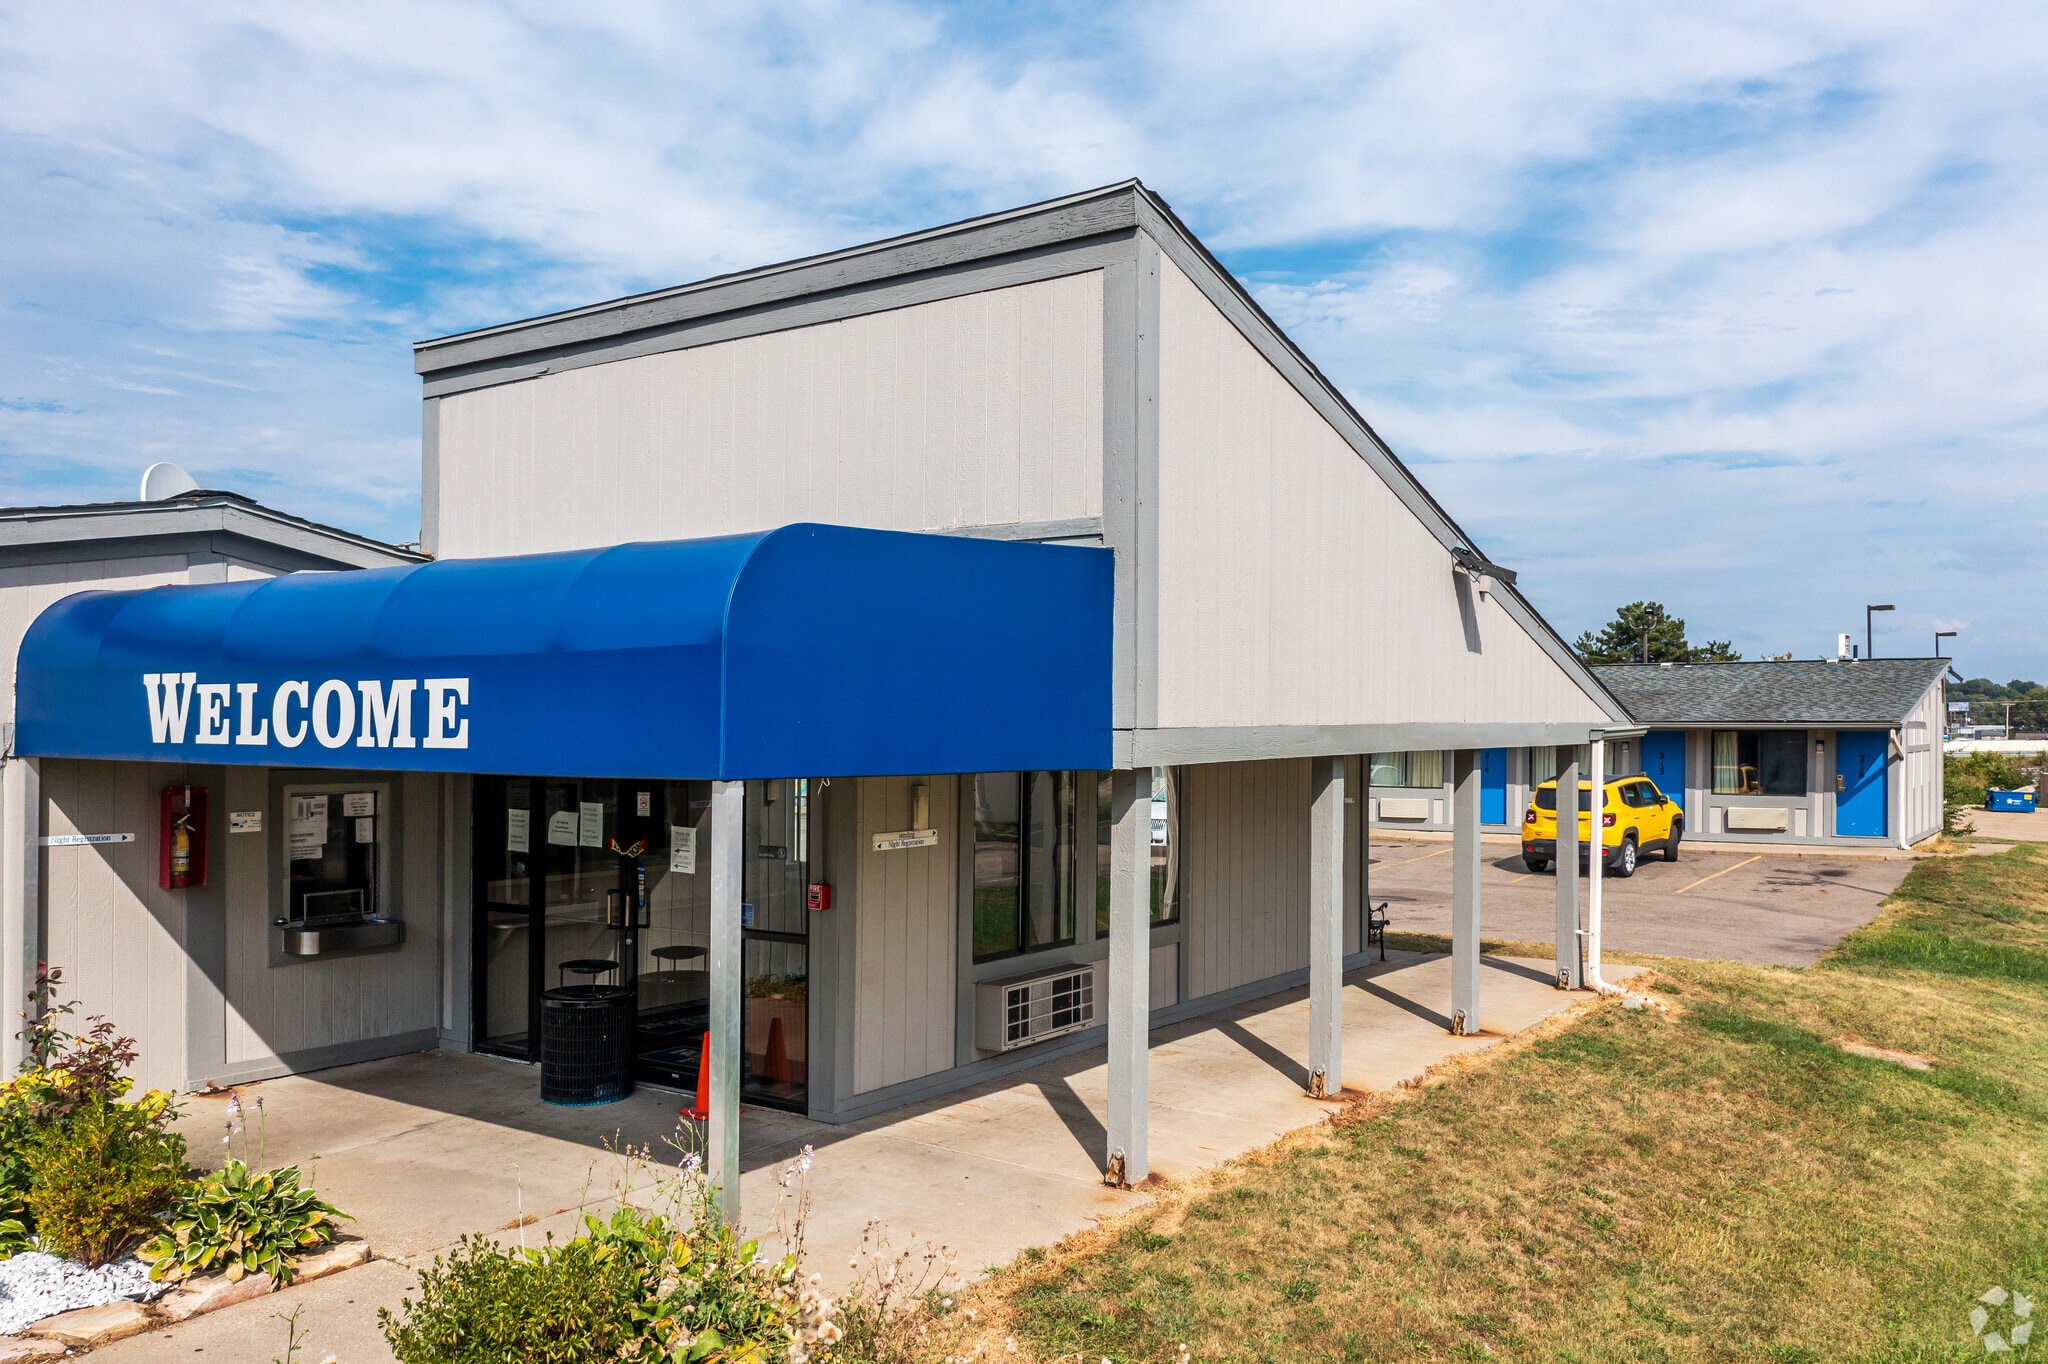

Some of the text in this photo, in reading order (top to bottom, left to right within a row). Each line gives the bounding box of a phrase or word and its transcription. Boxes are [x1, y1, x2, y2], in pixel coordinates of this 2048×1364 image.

[143, 672, 470, 749] WELCOME
[50, 834, 111, 845] Night Registration
[888, 840, 900, 849] Night
